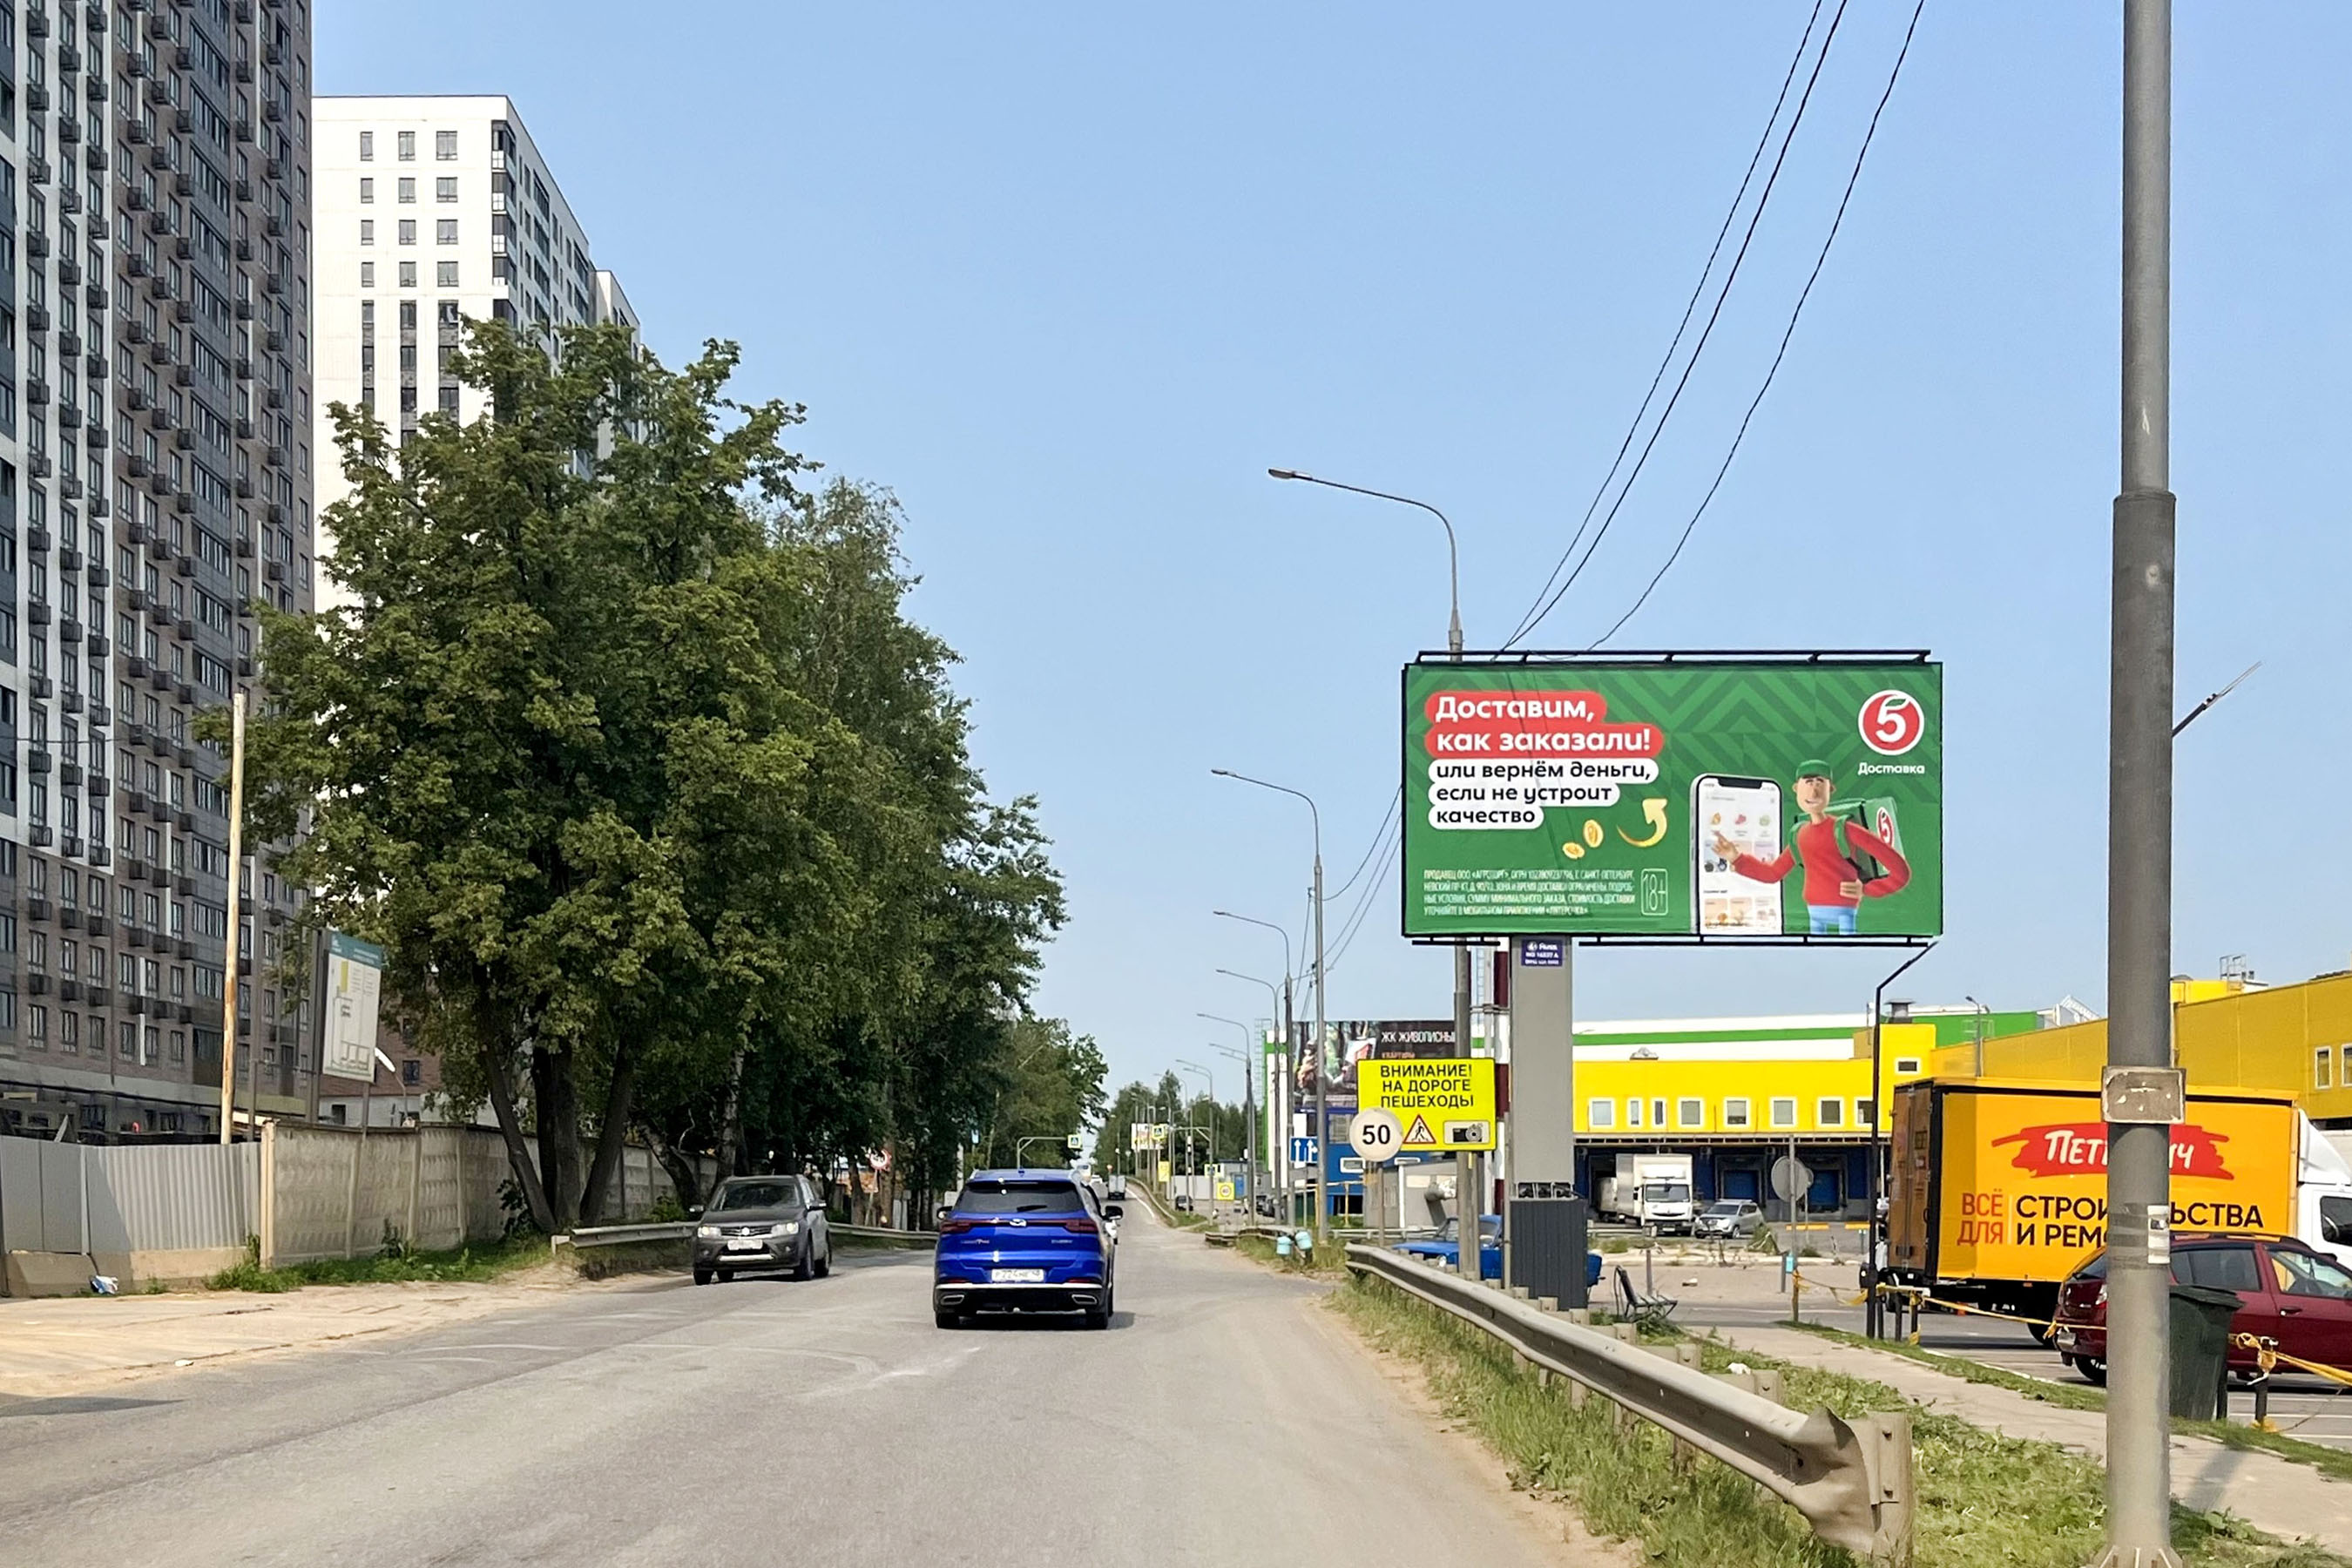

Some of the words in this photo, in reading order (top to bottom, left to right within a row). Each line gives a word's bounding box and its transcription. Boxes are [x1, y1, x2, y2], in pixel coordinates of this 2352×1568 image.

[1435, 696, 1595, 722] Доставим,
[1437, 732, 1491, 752] как
[1499, 728, 1651, 752] заказали!
[1436, 765, 1476, 778] или
[1482, 760, 1564, 781] вернём
[1570, 761, 1651, 781] деньги,
[1857, 761, 1925, 775] Доставка
[1436, 787, 1485, 801] если
[1492, 787, 1518, 801] не
[1524, 787, 1612, 804] устроит
[1436, 810, 1536, 823] качество
[1382, 1031, 1396, 1043] ЖК
[1398, 1031, 1456, 1043] ЖИВОПИСНЫ
[1380, 1064, 1472, 1078] ВНИМАНИЕ!
[1382, 1080, 1403, 1092] НА
[1408, 1079, 1471, 1094] ДОРОГЕ
[1381, 1095, 1474, 1108] ПЕШЕХОДЫ
[1362, 1124, 1390, 1145] 50
[1962, 1188, 2004, 1217] ВСЁ
[1957, 1220, 2004, 1247] ДЛЯ
[2017, 1222, 2035, 1246] И
